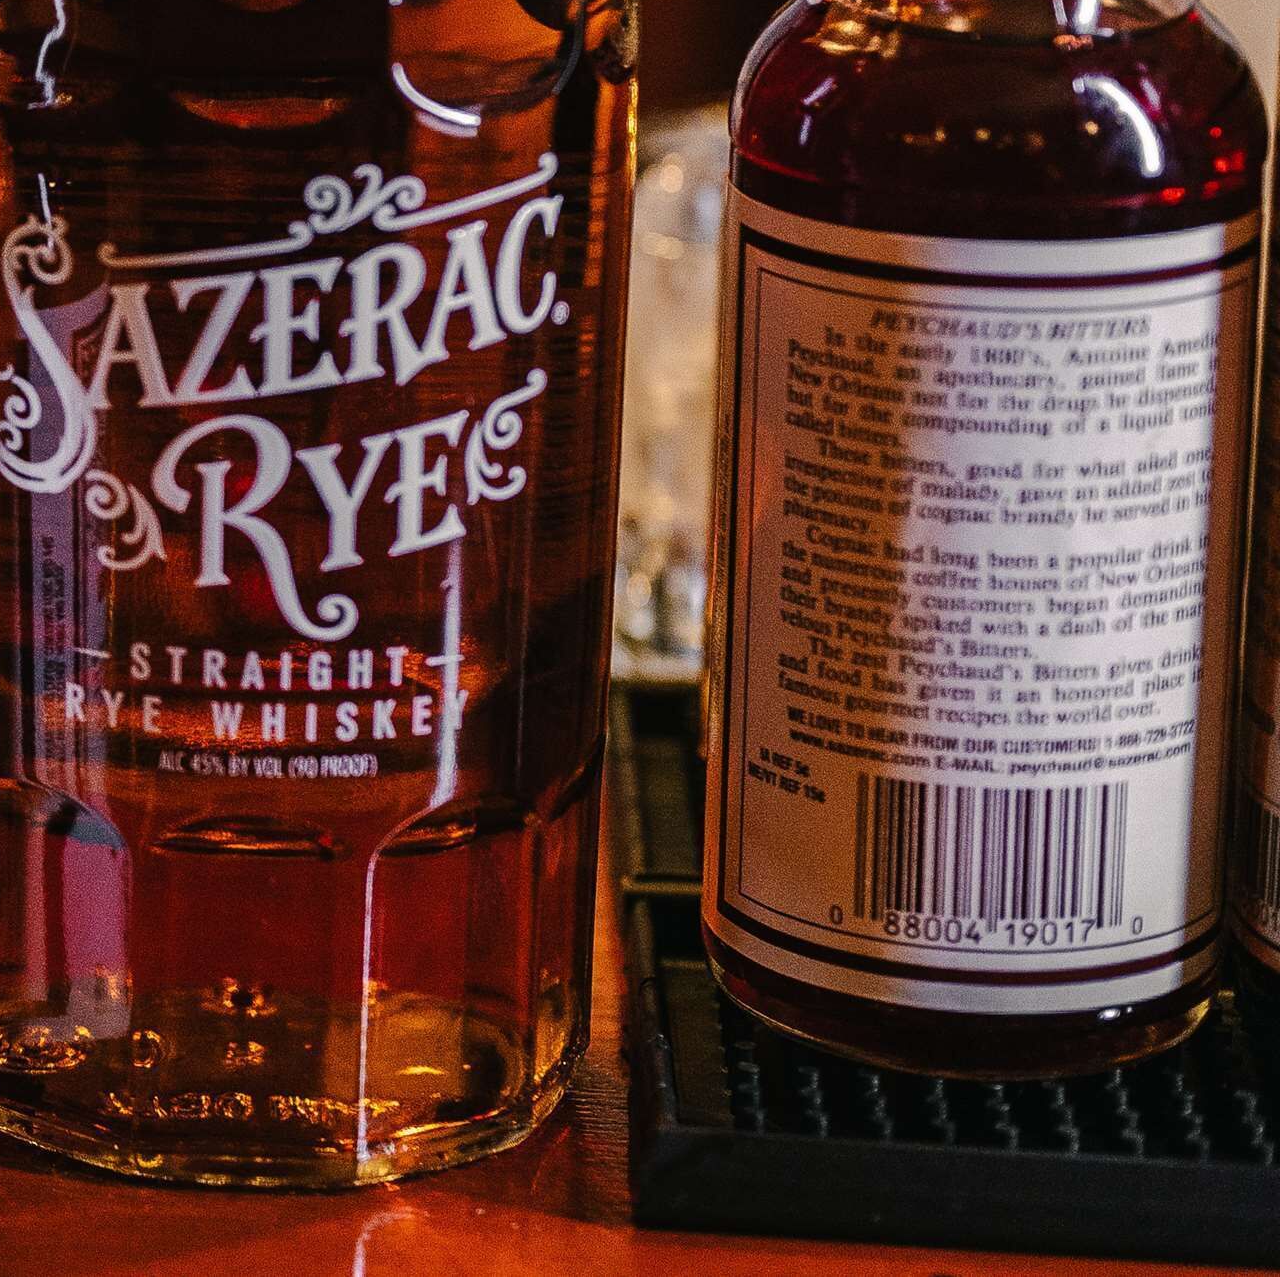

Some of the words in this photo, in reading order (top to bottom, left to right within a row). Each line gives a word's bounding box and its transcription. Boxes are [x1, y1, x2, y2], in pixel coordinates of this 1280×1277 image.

[150, 409, 470, 639] RYE
[130, 643, 407, 690] STRAIGHT
[64, 681, 162, 734] RYE
[211, 687, 469, 743] WHISKEY
[829, 903, 844, 925] 0
[883, 912, 983, 947] 88004
[1005, 919, 1096, 947] 19017
[1130, 915, 1145, 937] 0
